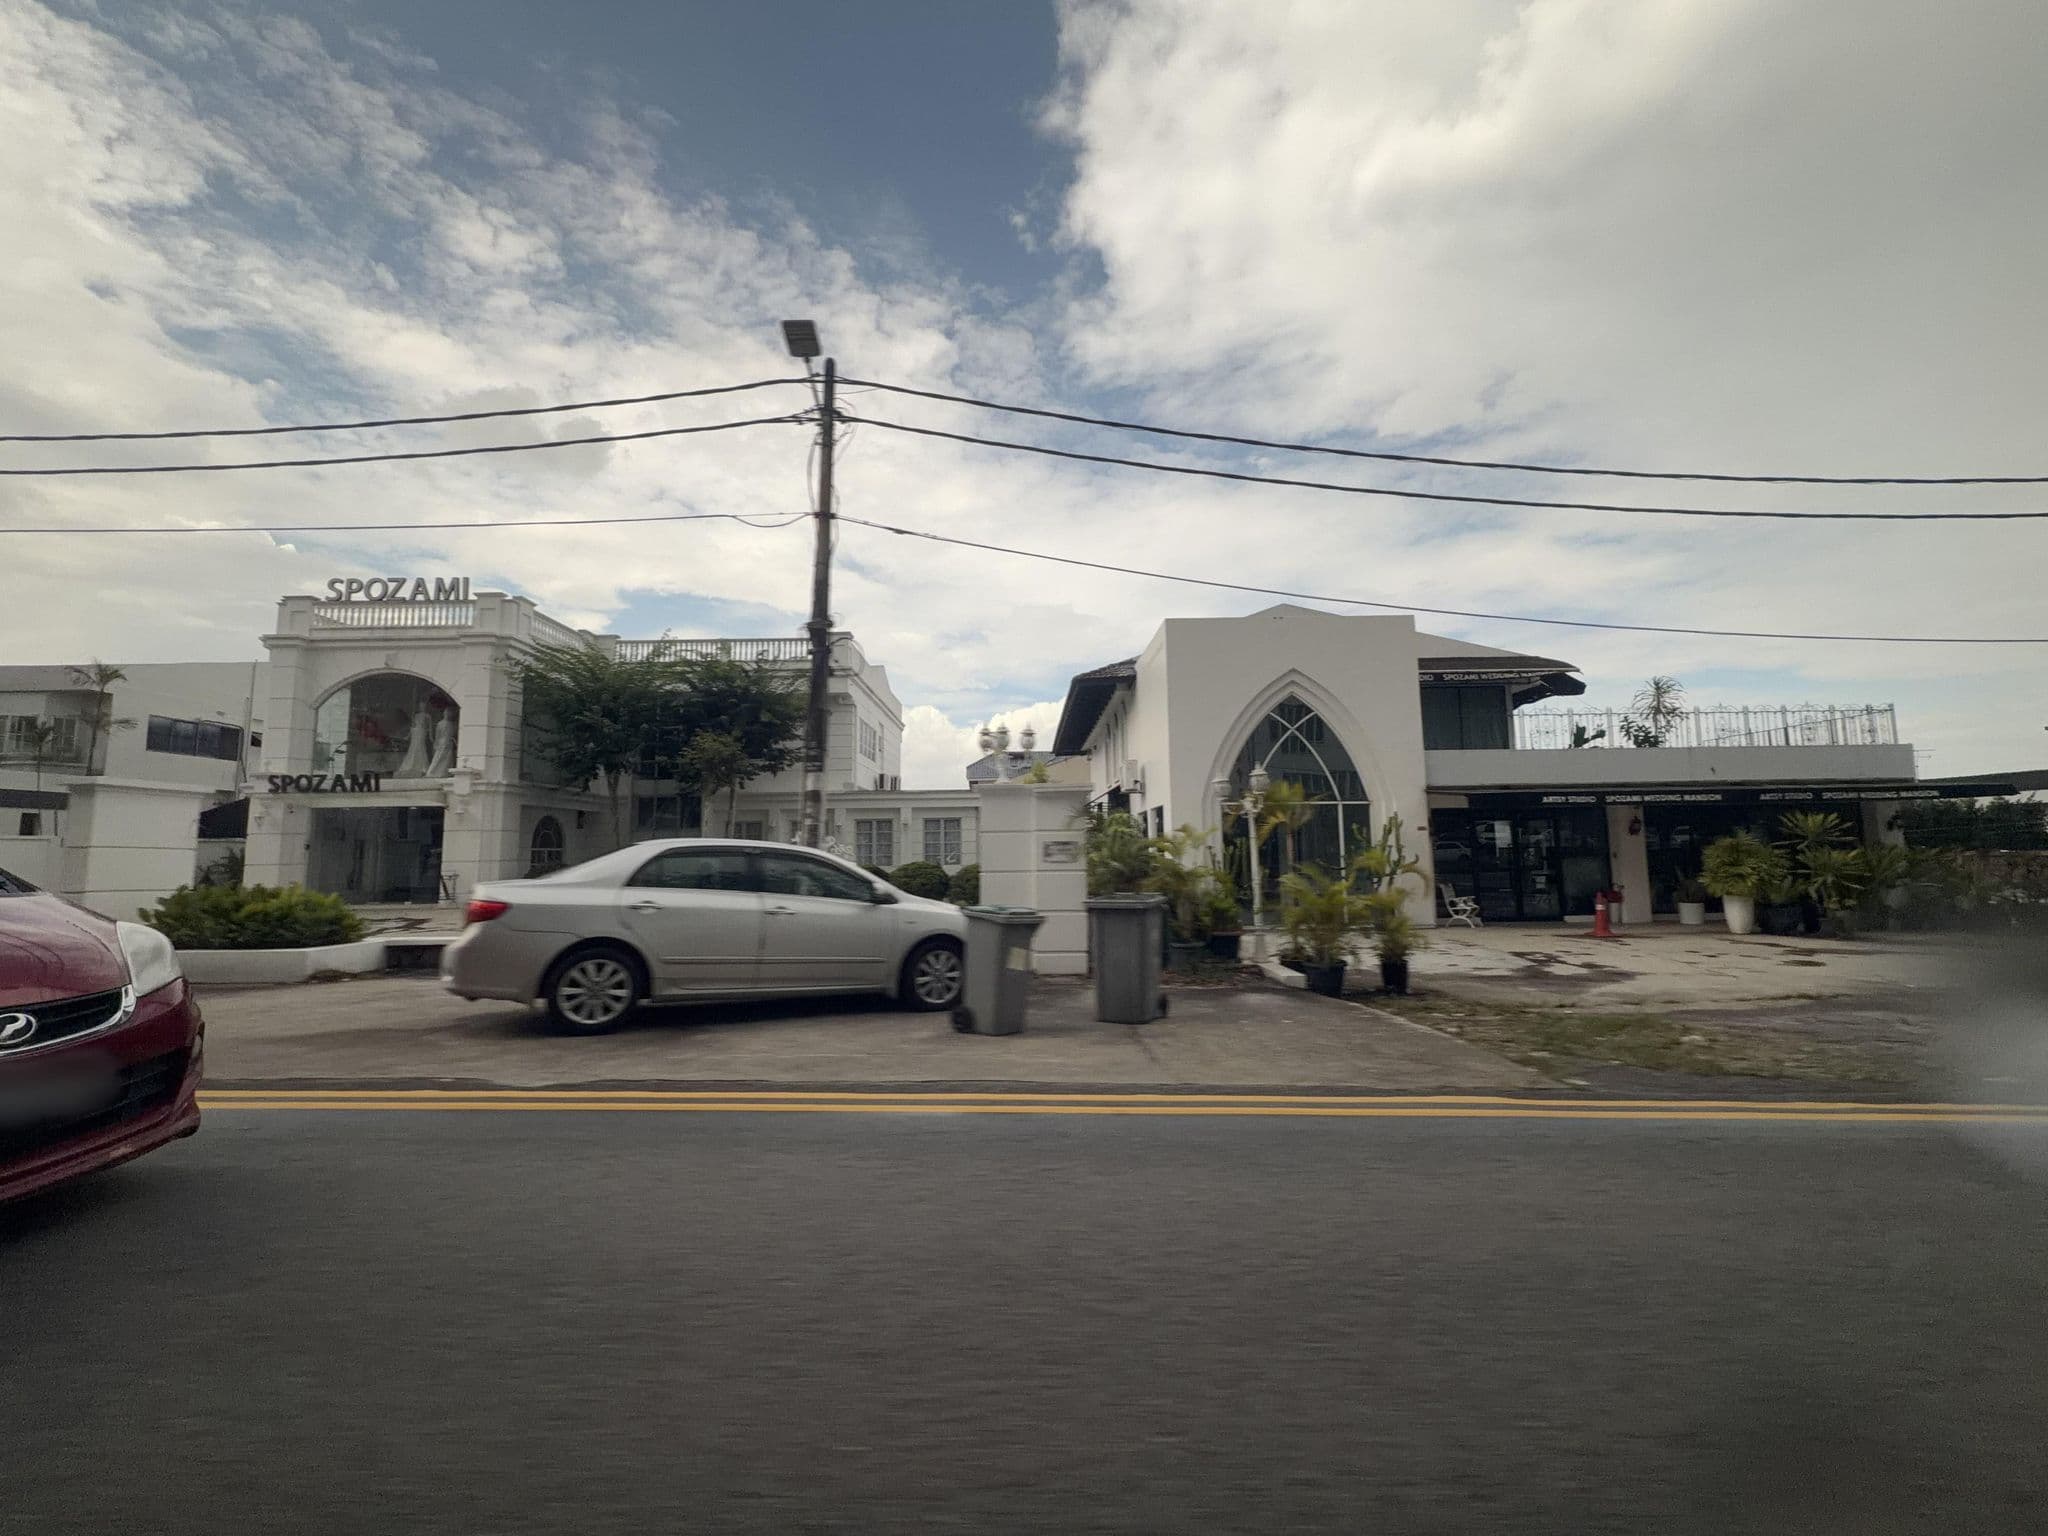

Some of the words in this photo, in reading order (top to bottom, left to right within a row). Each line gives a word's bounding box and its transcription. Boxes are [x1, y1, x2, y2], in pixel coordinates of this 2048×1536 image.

[325, 577, 470, 601] SPOZAMI
[1442, 673, 1479, 681] SPOZAMI
[1480, 672, 1519, 680] WEDDING
[268, 774, 380, 793] SPOZAMI
[1567, 795, 1597, 803] STUDIO
[1604, 794, 1643, 803] SPOZAMI
[1644, 794, 1682, 802] WEDDING
[1683, 793, 1722, 802] MANSION
[1822, 791, 1859, 800] SPOZAMI
